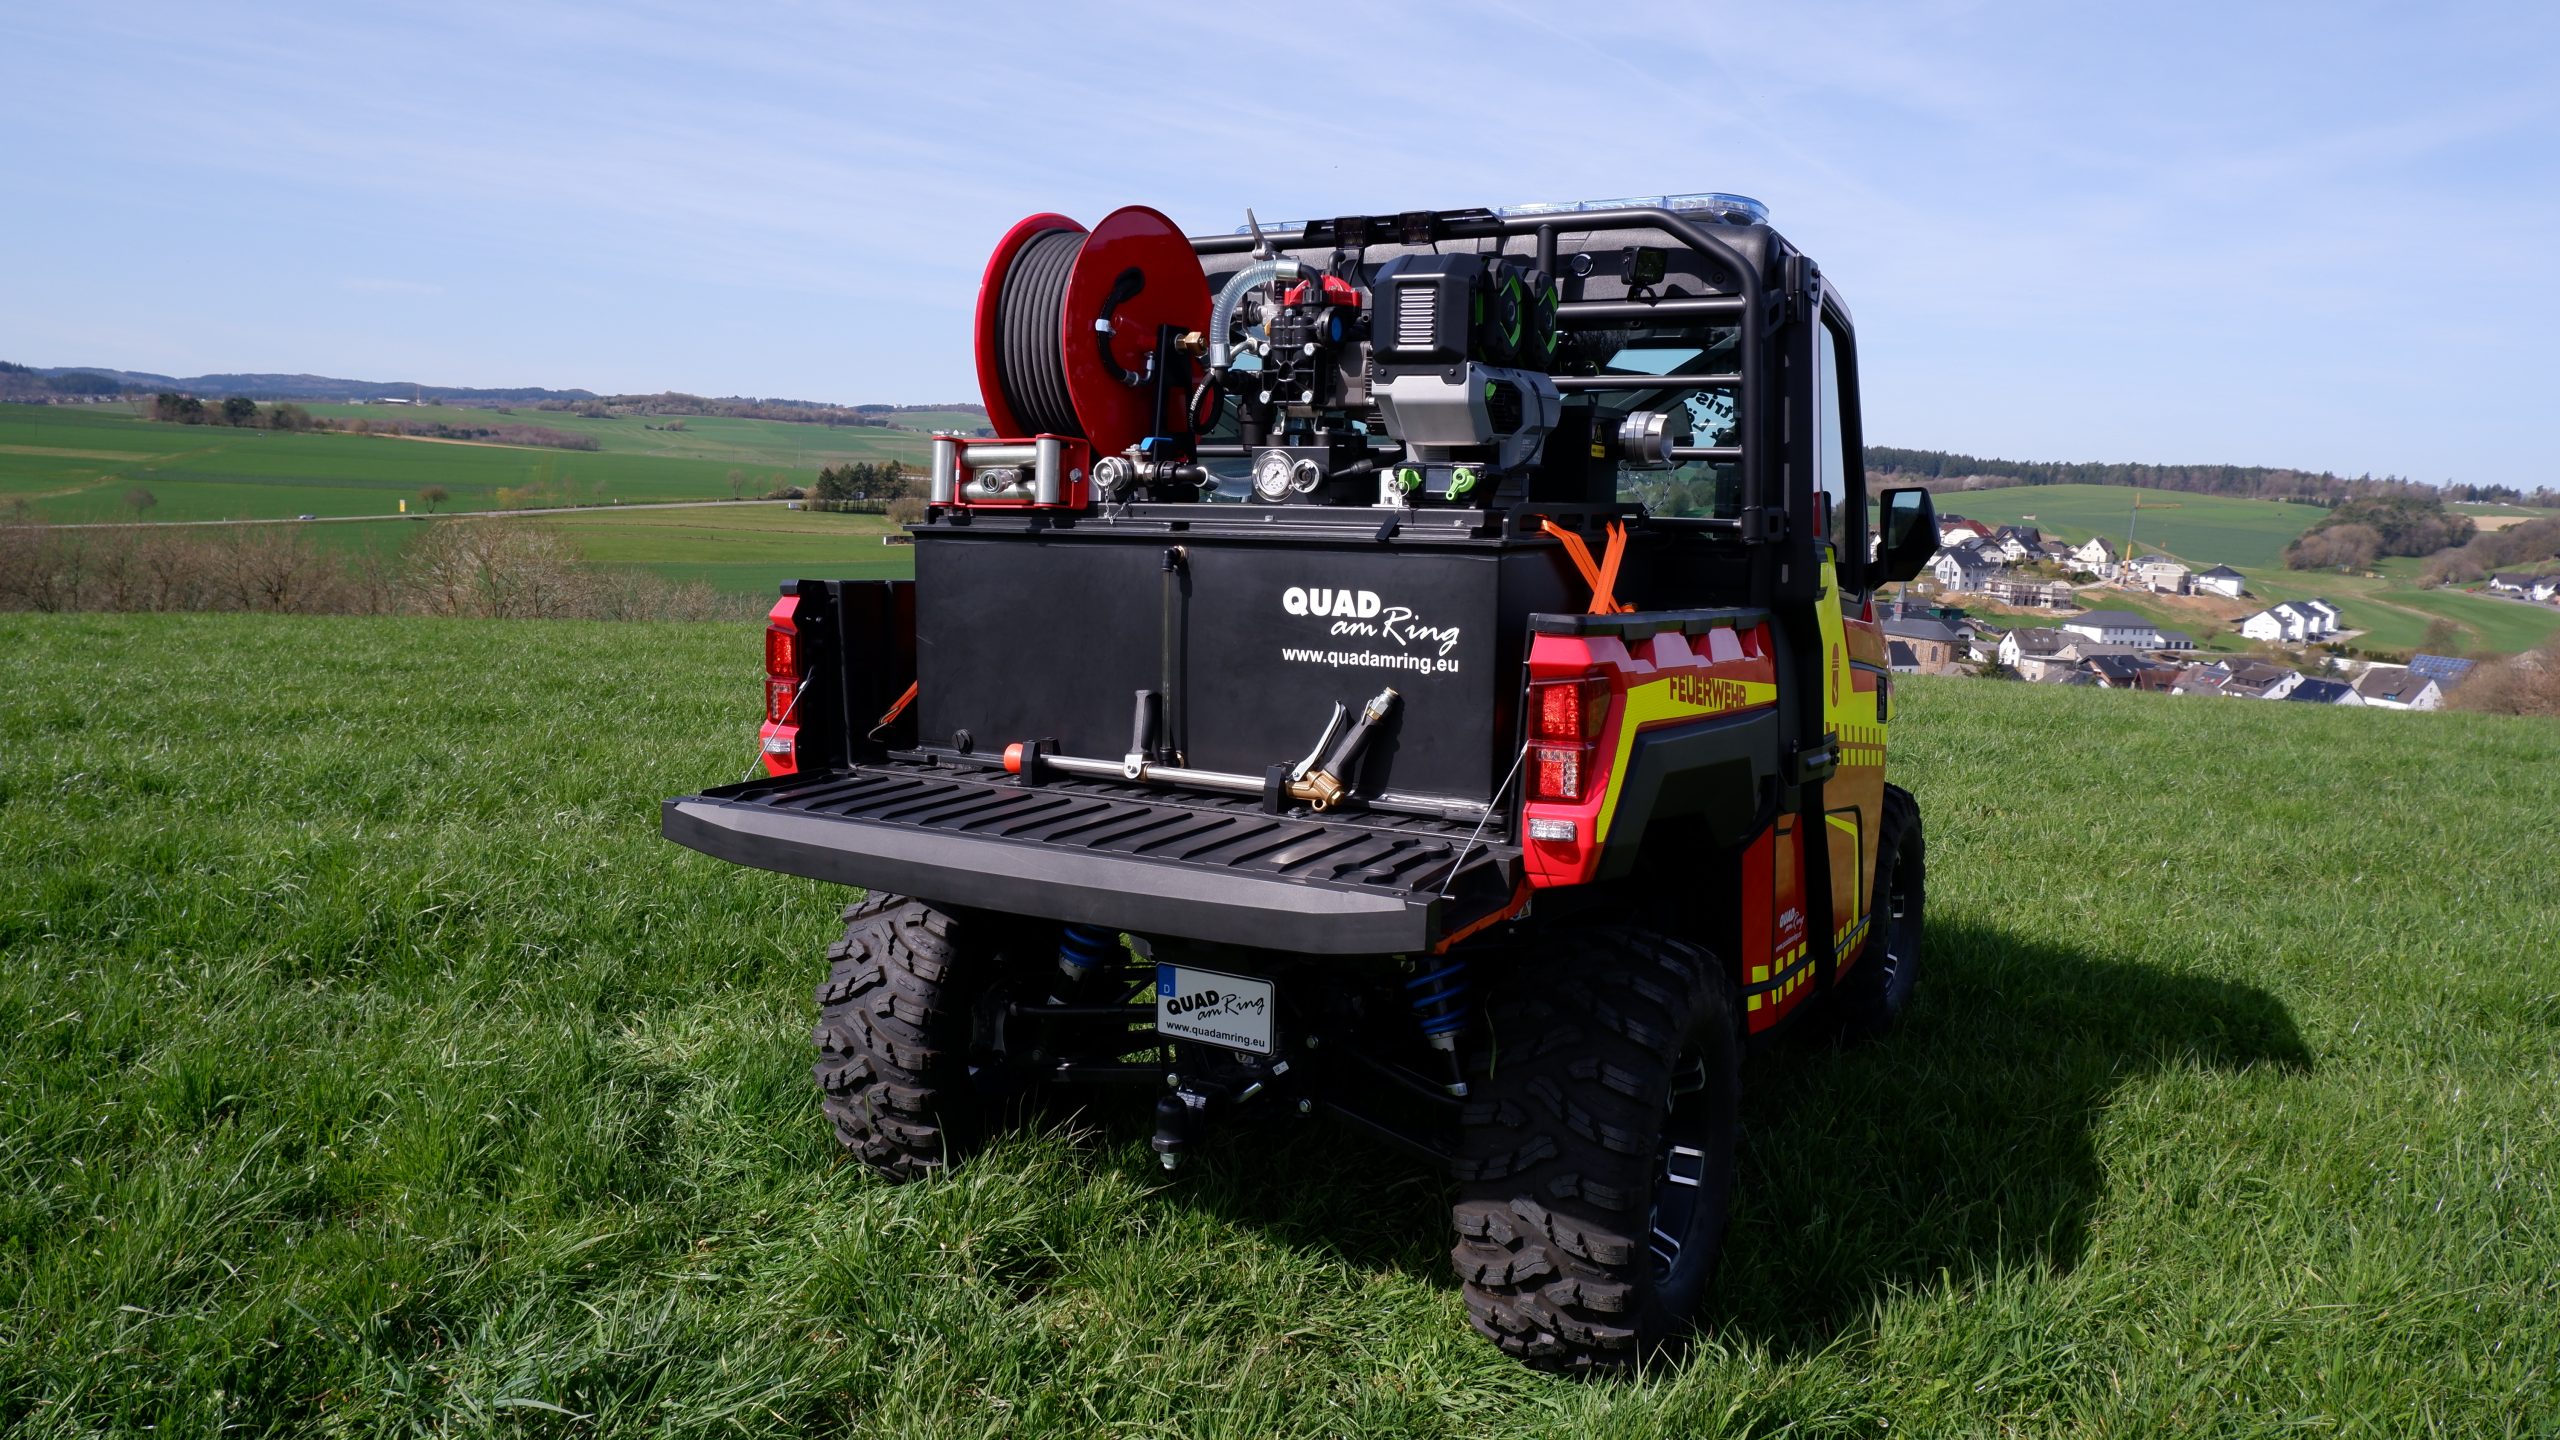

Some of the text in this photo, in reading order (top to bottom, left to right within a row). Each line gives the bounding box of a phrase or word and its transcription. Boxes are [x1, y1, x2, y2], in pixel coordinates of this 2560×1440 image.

[1282, 586, 1381, 618] QUAD
[1331, 606, 1460, 656] am Ring
[1282, 648, 1459, 675] www.quadamring.eu
[1669, 674, 1747, 711] FEUERWEHR
[1163, 984, 1171, 994] D
[1166, 990, 1220, 1015] QUAD
[1197, 993, 1265, 1021] am Ring
[1166, 1021, 1265, 1048] www.quadamring.eu
